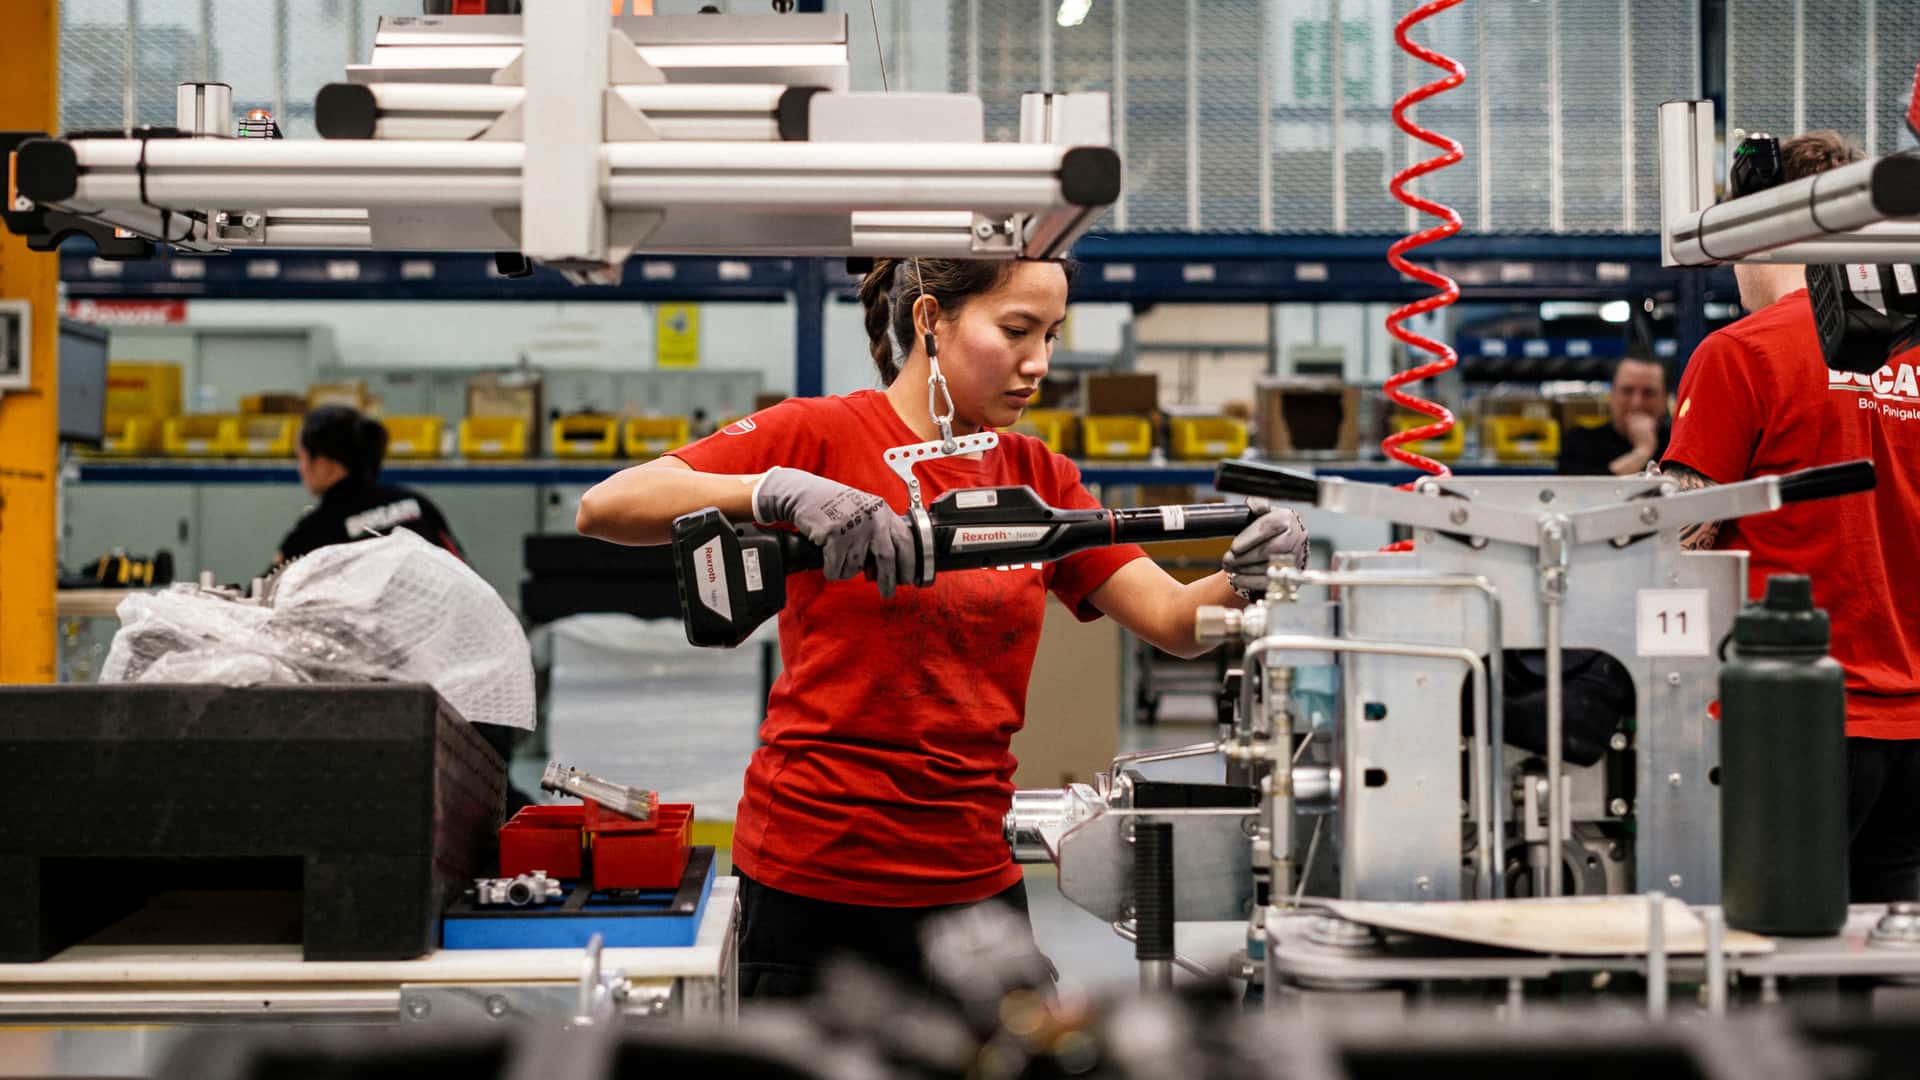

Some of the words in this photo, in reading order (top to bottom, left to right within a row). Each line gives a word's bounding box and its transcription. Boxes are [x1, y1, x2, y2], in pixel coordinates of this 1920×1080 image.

[962, 532, 1008, 542] Rexroth
[705, 547, 716, 583] Rexroth
[1656, 611, 1686, 634] 11
